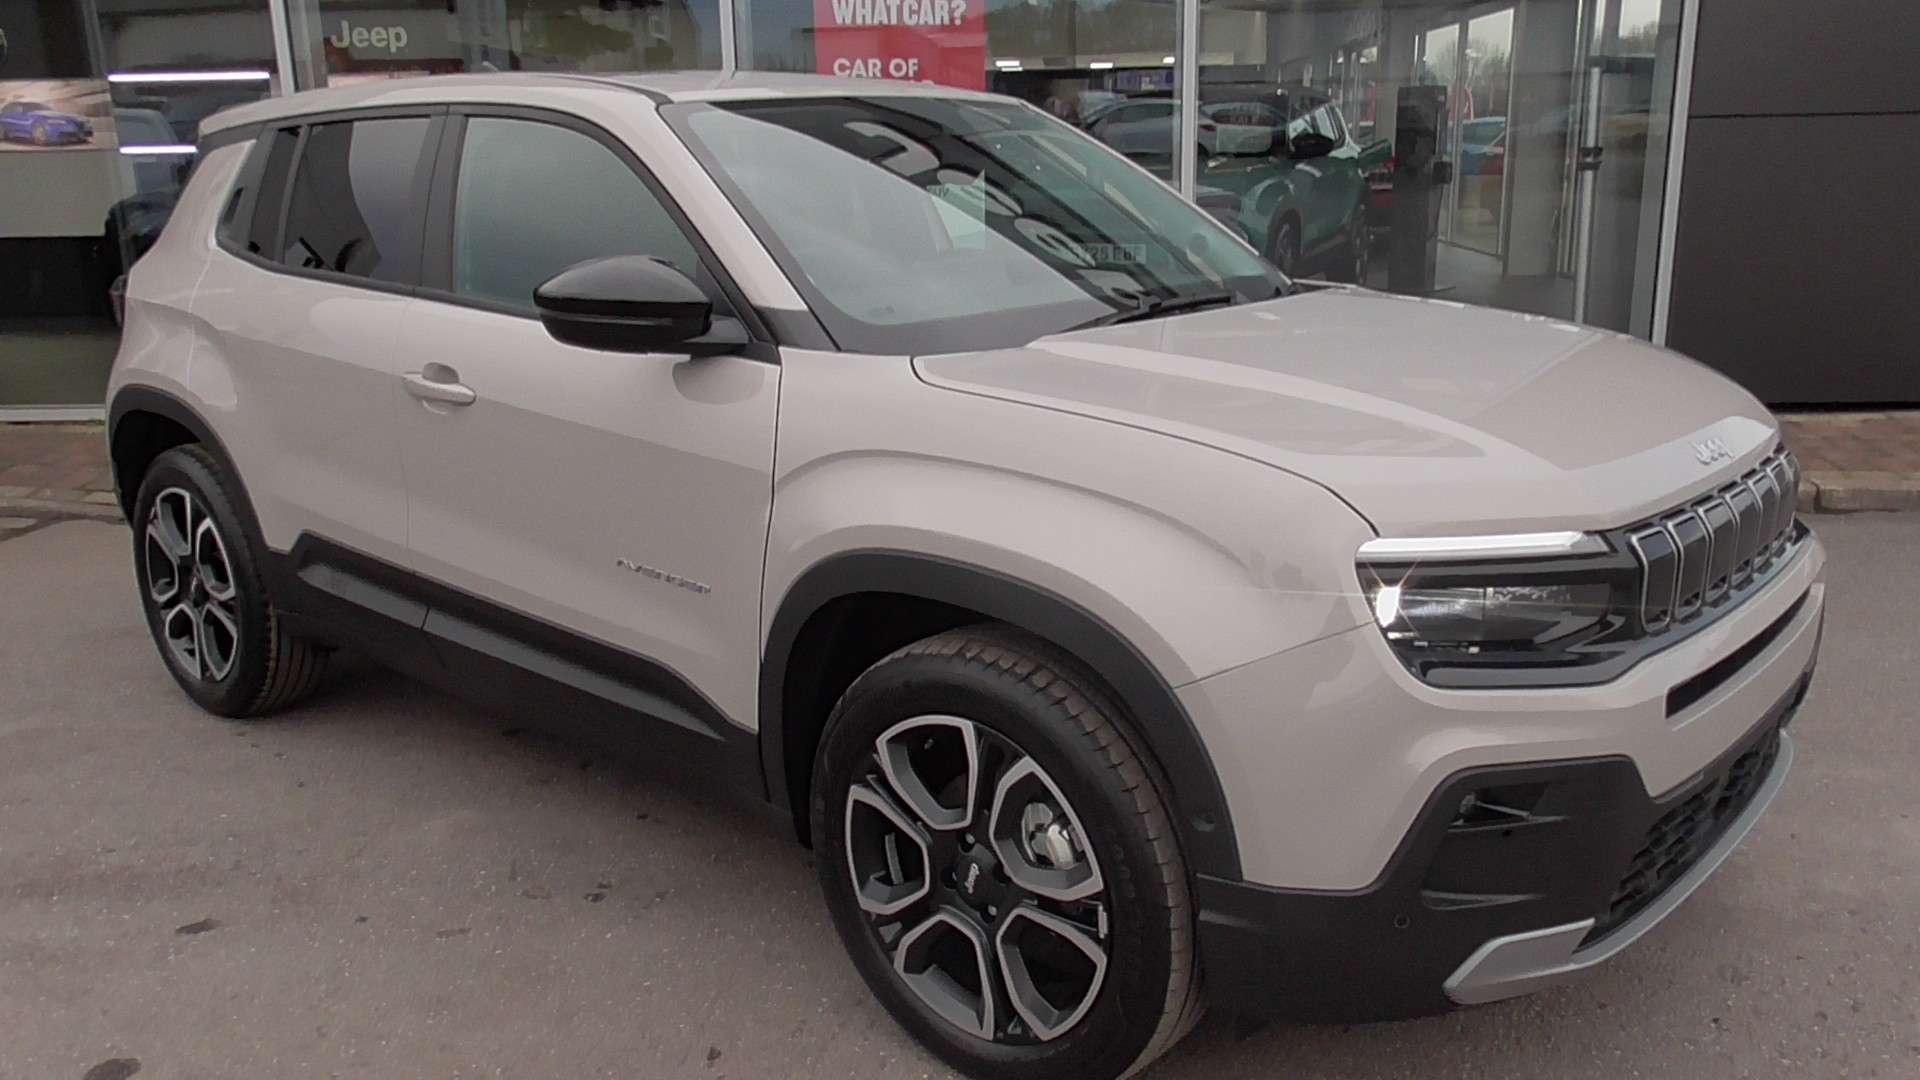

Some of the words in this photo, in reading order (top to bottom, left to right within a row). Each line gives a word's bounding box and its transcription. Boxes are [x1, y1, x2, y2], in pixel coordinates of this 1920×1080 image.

[330, 19, 408, 53] Jeep
[833, 57, 882, 78] CAR
[888, 57, 919, 78] OF
